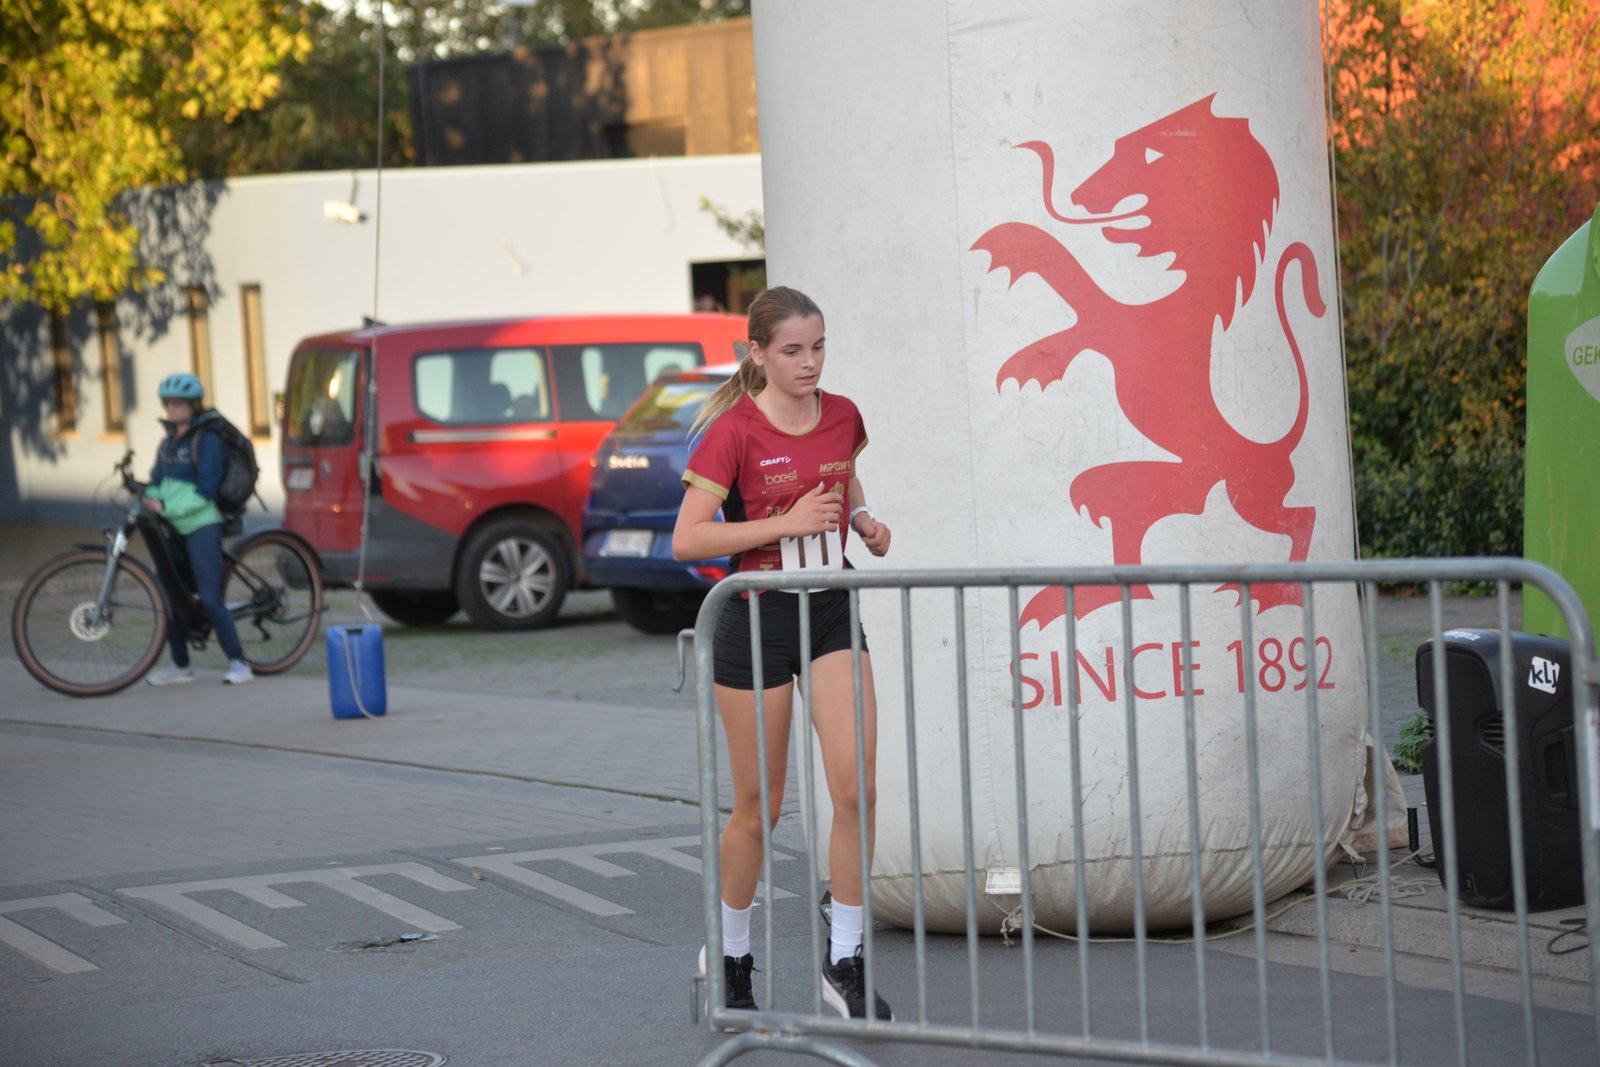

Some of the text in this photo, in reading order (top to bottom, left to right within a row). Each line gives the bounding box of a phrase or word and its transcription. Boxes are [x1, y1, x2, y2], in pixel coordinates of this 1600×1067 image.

[760, 456, 786, 467] CRAFT
[1010, 636, 1336, 710] SINCE 1892
